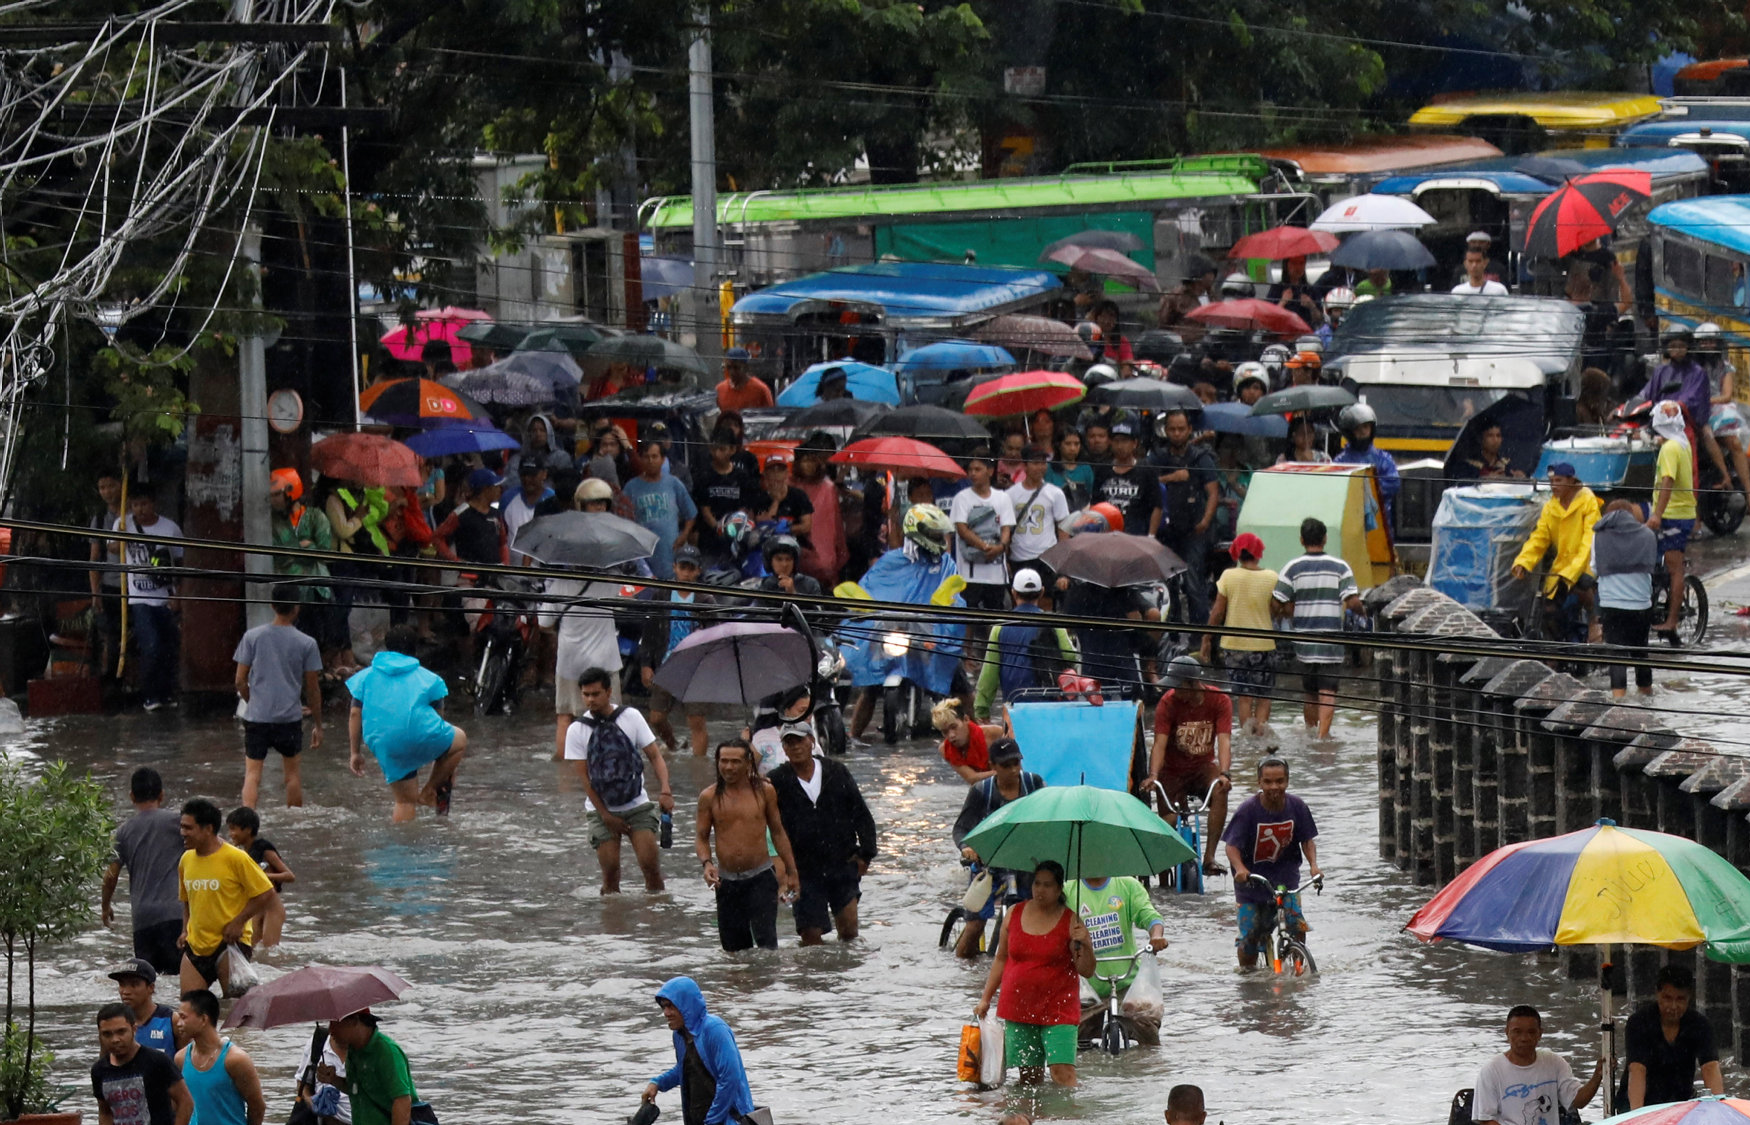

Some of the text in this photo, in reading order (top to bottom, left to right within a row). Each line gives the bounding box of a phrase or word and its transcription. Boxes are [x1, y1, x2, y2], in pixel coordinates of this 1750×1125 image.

[1015, 503, 1045, 535] 23
[1085, 912, 1119, 928] CLEANING
[1092, 934, 1124, 949] ERATIONS
